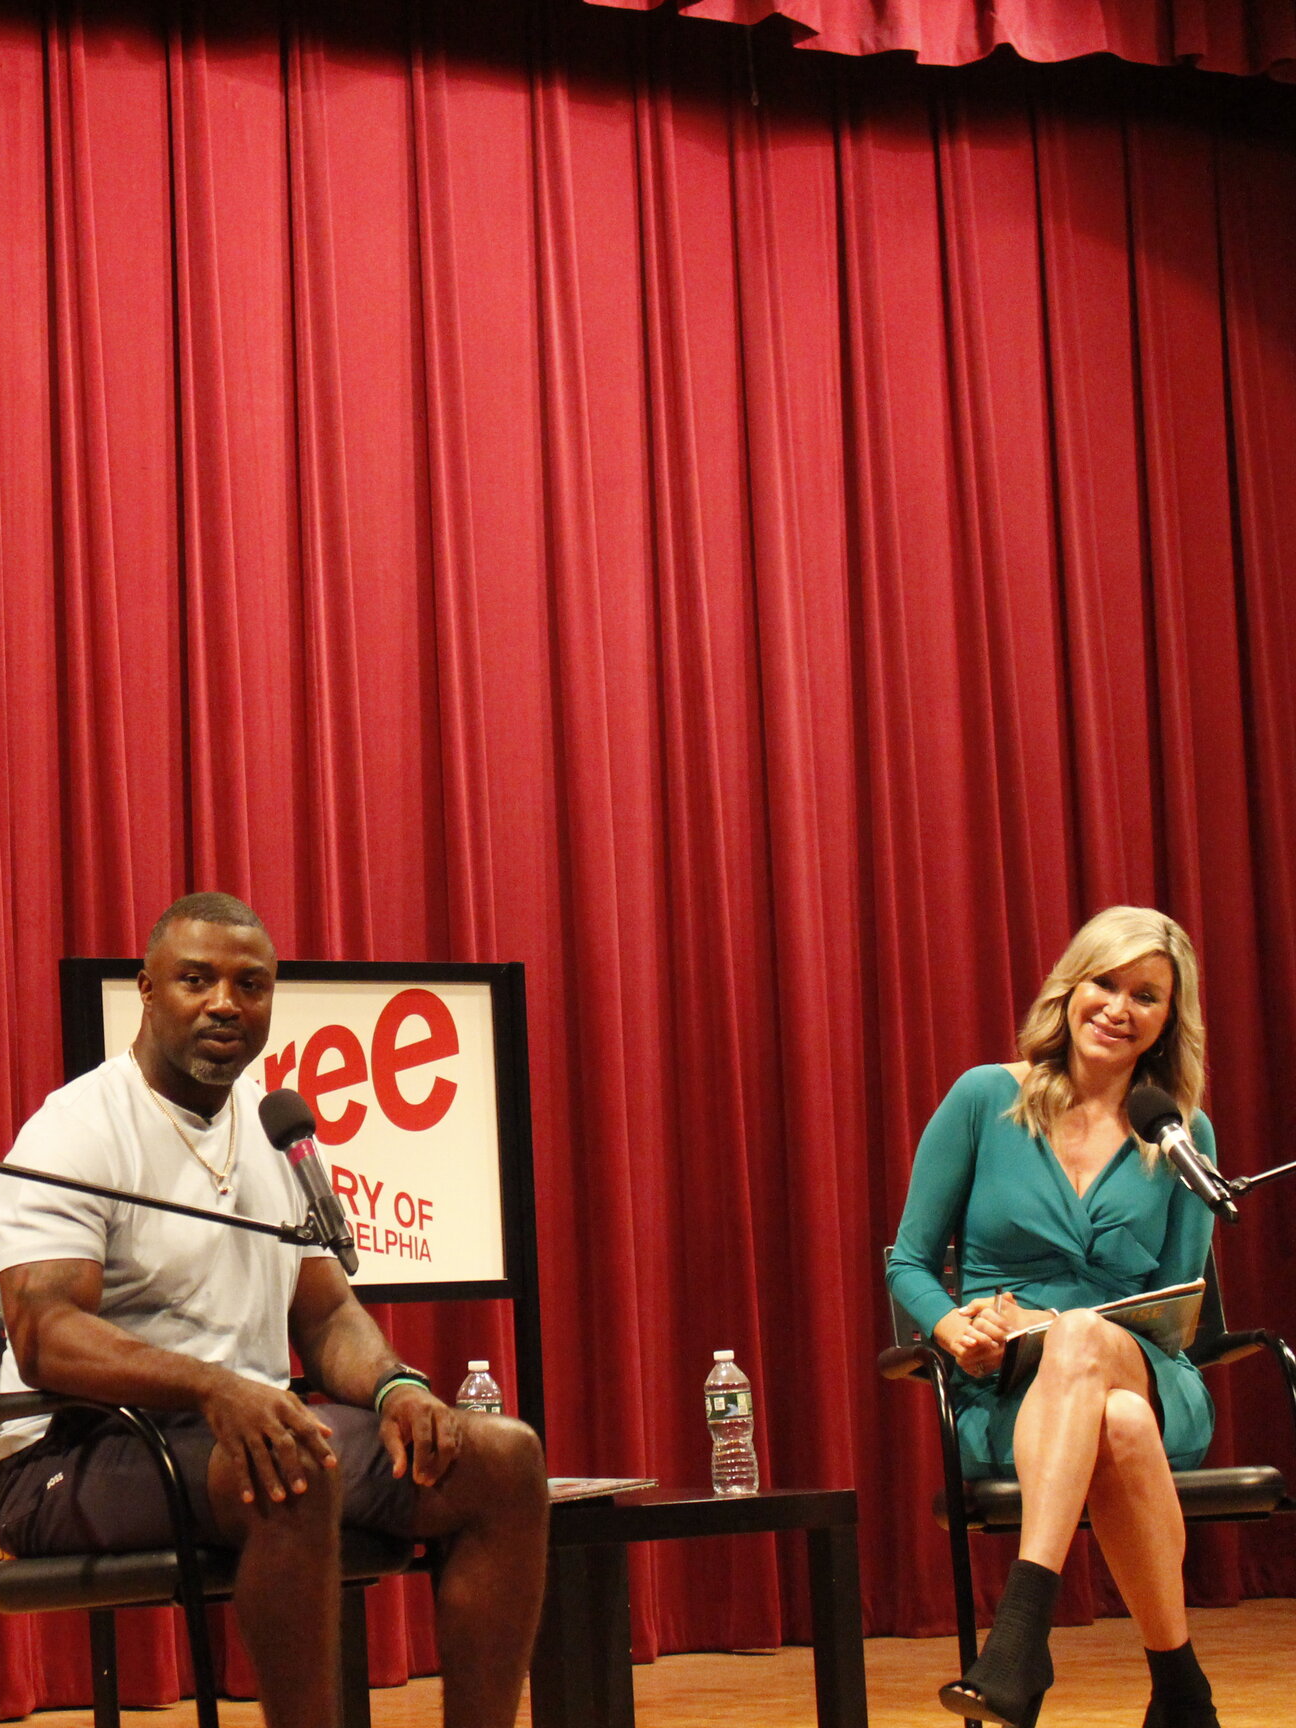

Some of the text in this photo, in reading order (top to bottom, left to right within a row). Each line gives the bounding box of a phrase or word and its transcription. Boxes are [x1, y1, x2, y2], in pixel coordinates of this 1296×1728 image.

[256, 988, 460, 1147] ree
[394, 1191, 433, 1231] OF
[345, 1220, 432, 1263] ELPHIA
